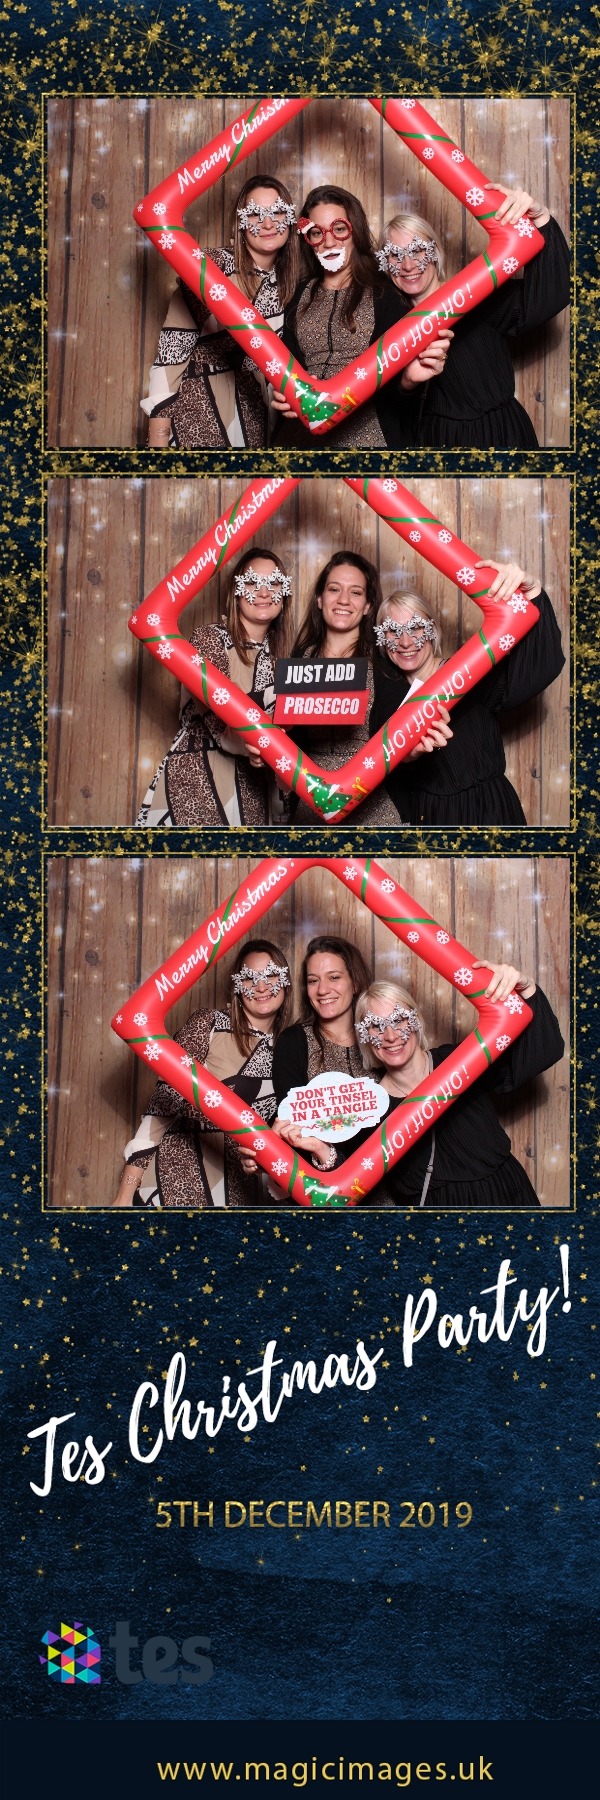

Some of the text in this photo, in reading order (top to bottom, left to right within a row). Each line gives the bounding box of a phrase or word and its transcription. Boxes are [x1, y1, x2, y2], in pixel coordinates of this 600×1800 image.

[177, 98, 290, 194] Merry Christ
[166, 547, 217, 603] Merry
[285, 663, 356, 684] JUST ADD
[283, 696, 360, 715] PROSECCO
[154, 945, 209, 1001] Merry
[290, 1090, 377, 1112] YOUR TINSEL
[295, 1081, 365, 1101] DON'T GET
[292, 1100, 378, 1122] IN A TANGLE
